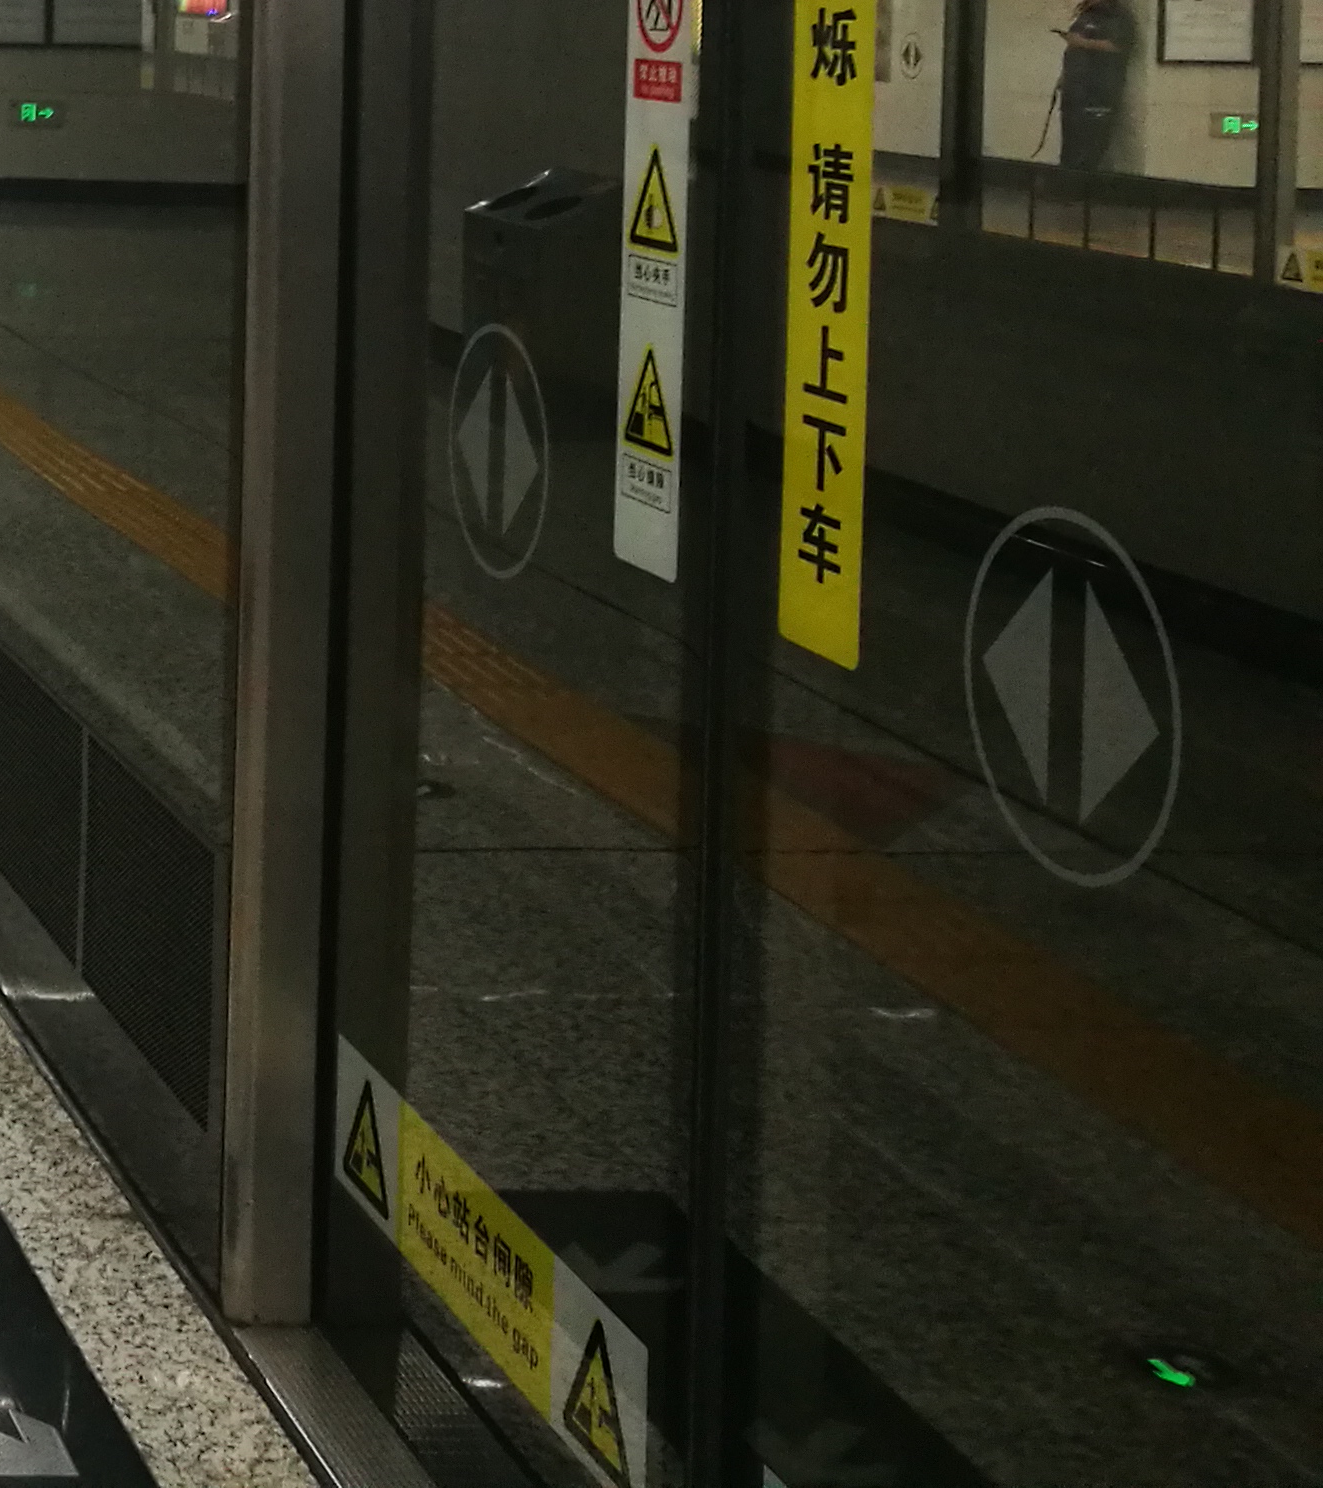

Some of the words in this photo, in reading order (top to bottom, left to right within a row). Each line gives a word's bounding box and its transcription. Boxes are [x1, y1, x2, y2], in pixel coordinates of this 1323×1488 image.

[797, 141, 856, 585] 请勿上下车
[407, 1202, 447, 1266] Please
[450, 1256, 483, 1308] mind
[485, 1295, 508, 1335] the
[511, 1327, 539, 1371] gap
[415, 1153, 534, 1314] 小心站台间隙
